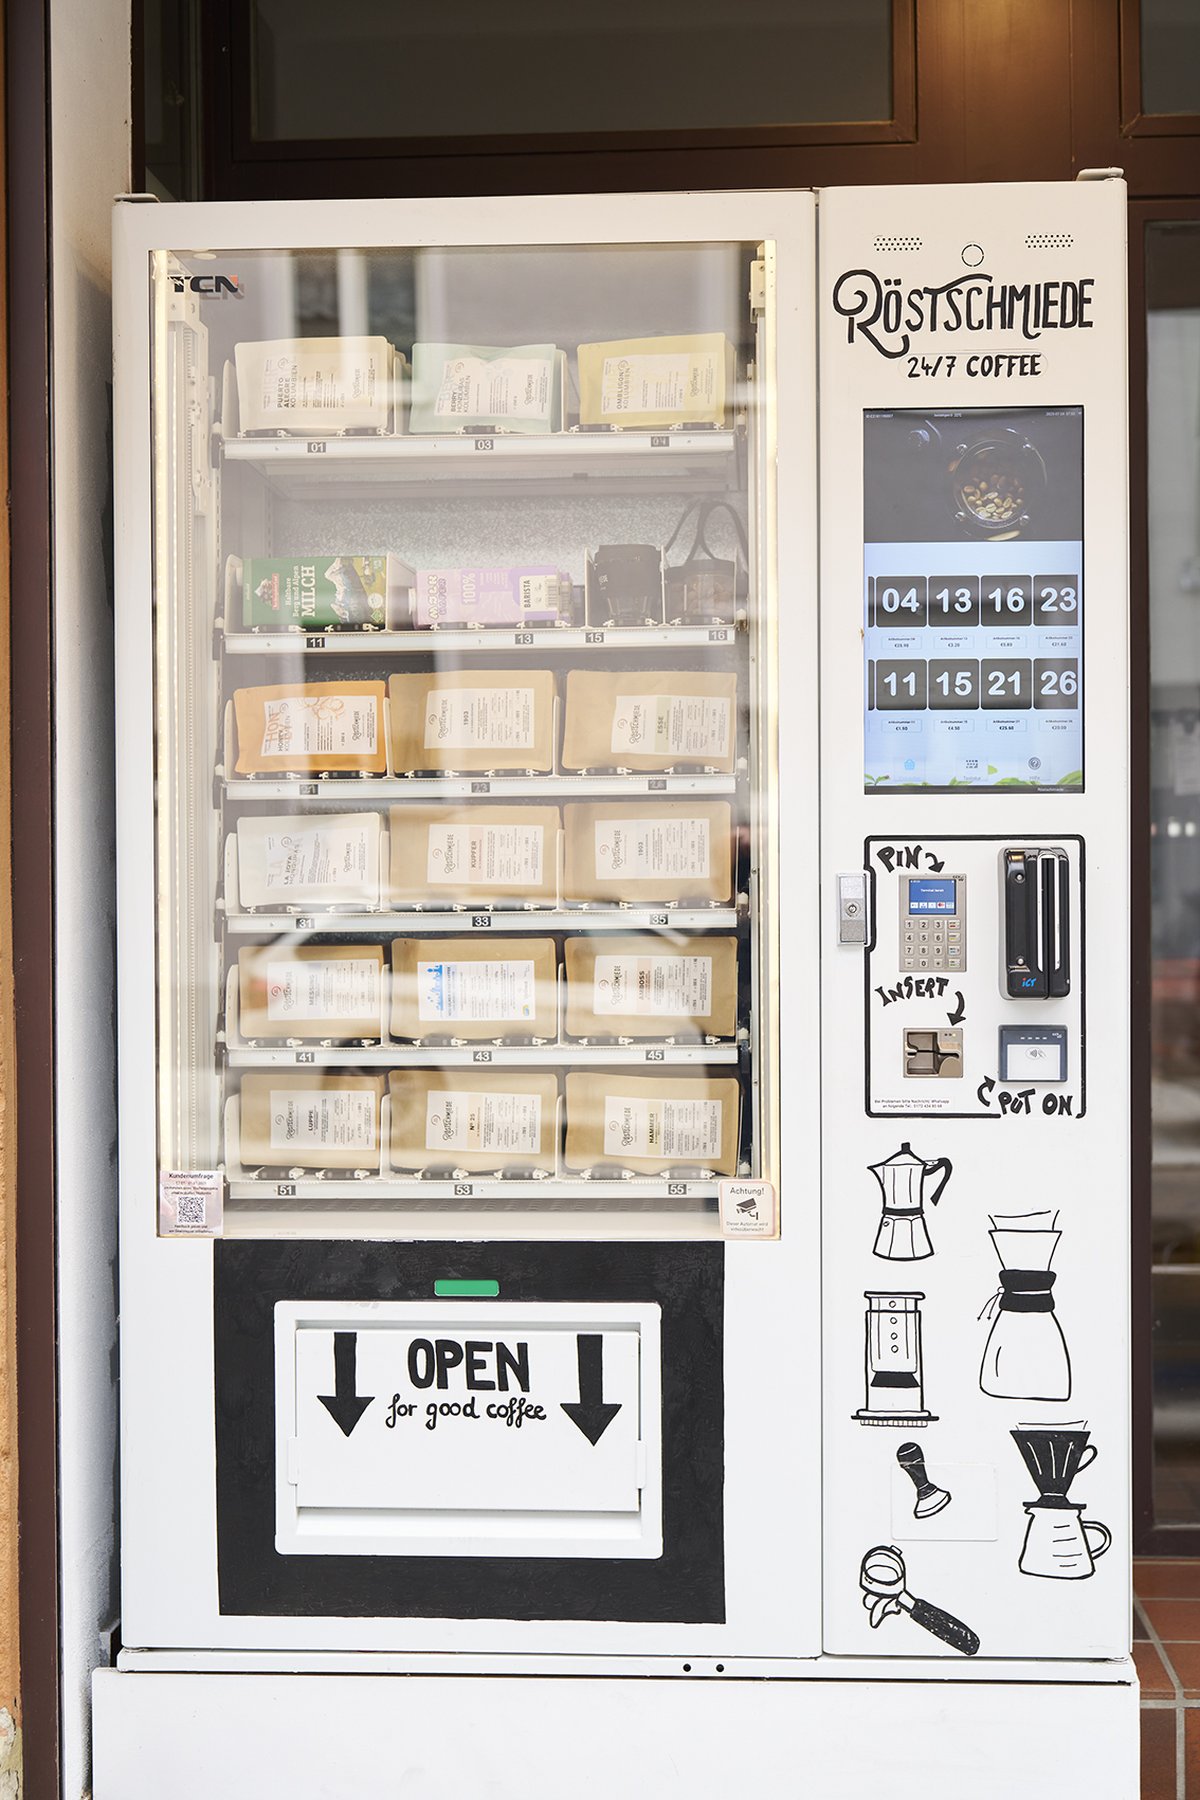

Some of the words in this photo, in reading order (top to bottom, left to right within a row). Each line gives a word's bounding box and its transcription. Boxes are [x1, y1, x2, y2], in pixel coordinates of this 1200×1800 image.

[167, 274, 240, 293] TCN
[833, 268, 1096, 359] RÖSTSCHMIEDE
[907, 356, 957, 378] 24/7
[966, 354, 1043, 378] COFFEE
[277, 377, 285, 408] PUERTO
[290, 364, 299, 408] KOLUMBIEN
[457, 377, 465, 413] HONDURAS
[463, 375, 471, 413] KOLUMBIEN
[616, 371, 624, 409] OMBLIGON
[624, 367, 632, 409] KOLUMBIEN
[450, 391, 458, 412] BERRY
[310, 442, 323, 453] 01
[478, 440, 492, 450] 03
[653, 436, 667, 446] 04
[292, 565, 300, 586] Alpen
[301, 565, 316, 617] MILCH
[463, 572, 477, 604] 100%
[523, 580, 531, 608] BARISTA
[882, 587, 919, 613] 04
[936, 587, 972, 613] 13
[988, 587, 1025, 613] 16
[1040, 587, 1077, 612] 23
[292, 601, 301, 617] Berg
[310, 638, 323, 648] 11
[518, 634, 531, 643] 13
[588, 632, 602, 642] 15
[711, 630, 725, 640] 16
[883, 671, 915, 696] 11
[936, 671, 973, 696] 15
[988, 671, 1021, 696] 21
[1040, 670, 1077, 695] 26
[473, 783, 488, 792] 23
[876, 844, 923, 873] PIN
[283, 875, 289, 885] LA
[299, 918, 312, 928] 31
[475, 917, 489, 926] 33
[652, 914, 666, 924] 35
[874, 976, 950, 1007] INSERT
[298, 1053, 312, 1062] 41
[475, 1052, 489, 1061] 43
[647, 1050, 663, 1060] 45
[998, 1088, 1036, 1115] PUT
[1042, 1093, 1073, 1116] ON
[280, 1185, 293, 1195] 51
[456, 1185, 470, 1194] 53
[670, 1185, 684, 1194] 55
[730, 1187, 765, 1196] Achtung!
[407, 1338, 530, 1393] OPEN
[385, 1393, 418, 1429] for
[426, 1396, 481, 1430] good
[486, 1397, 548, 1429] coffee
